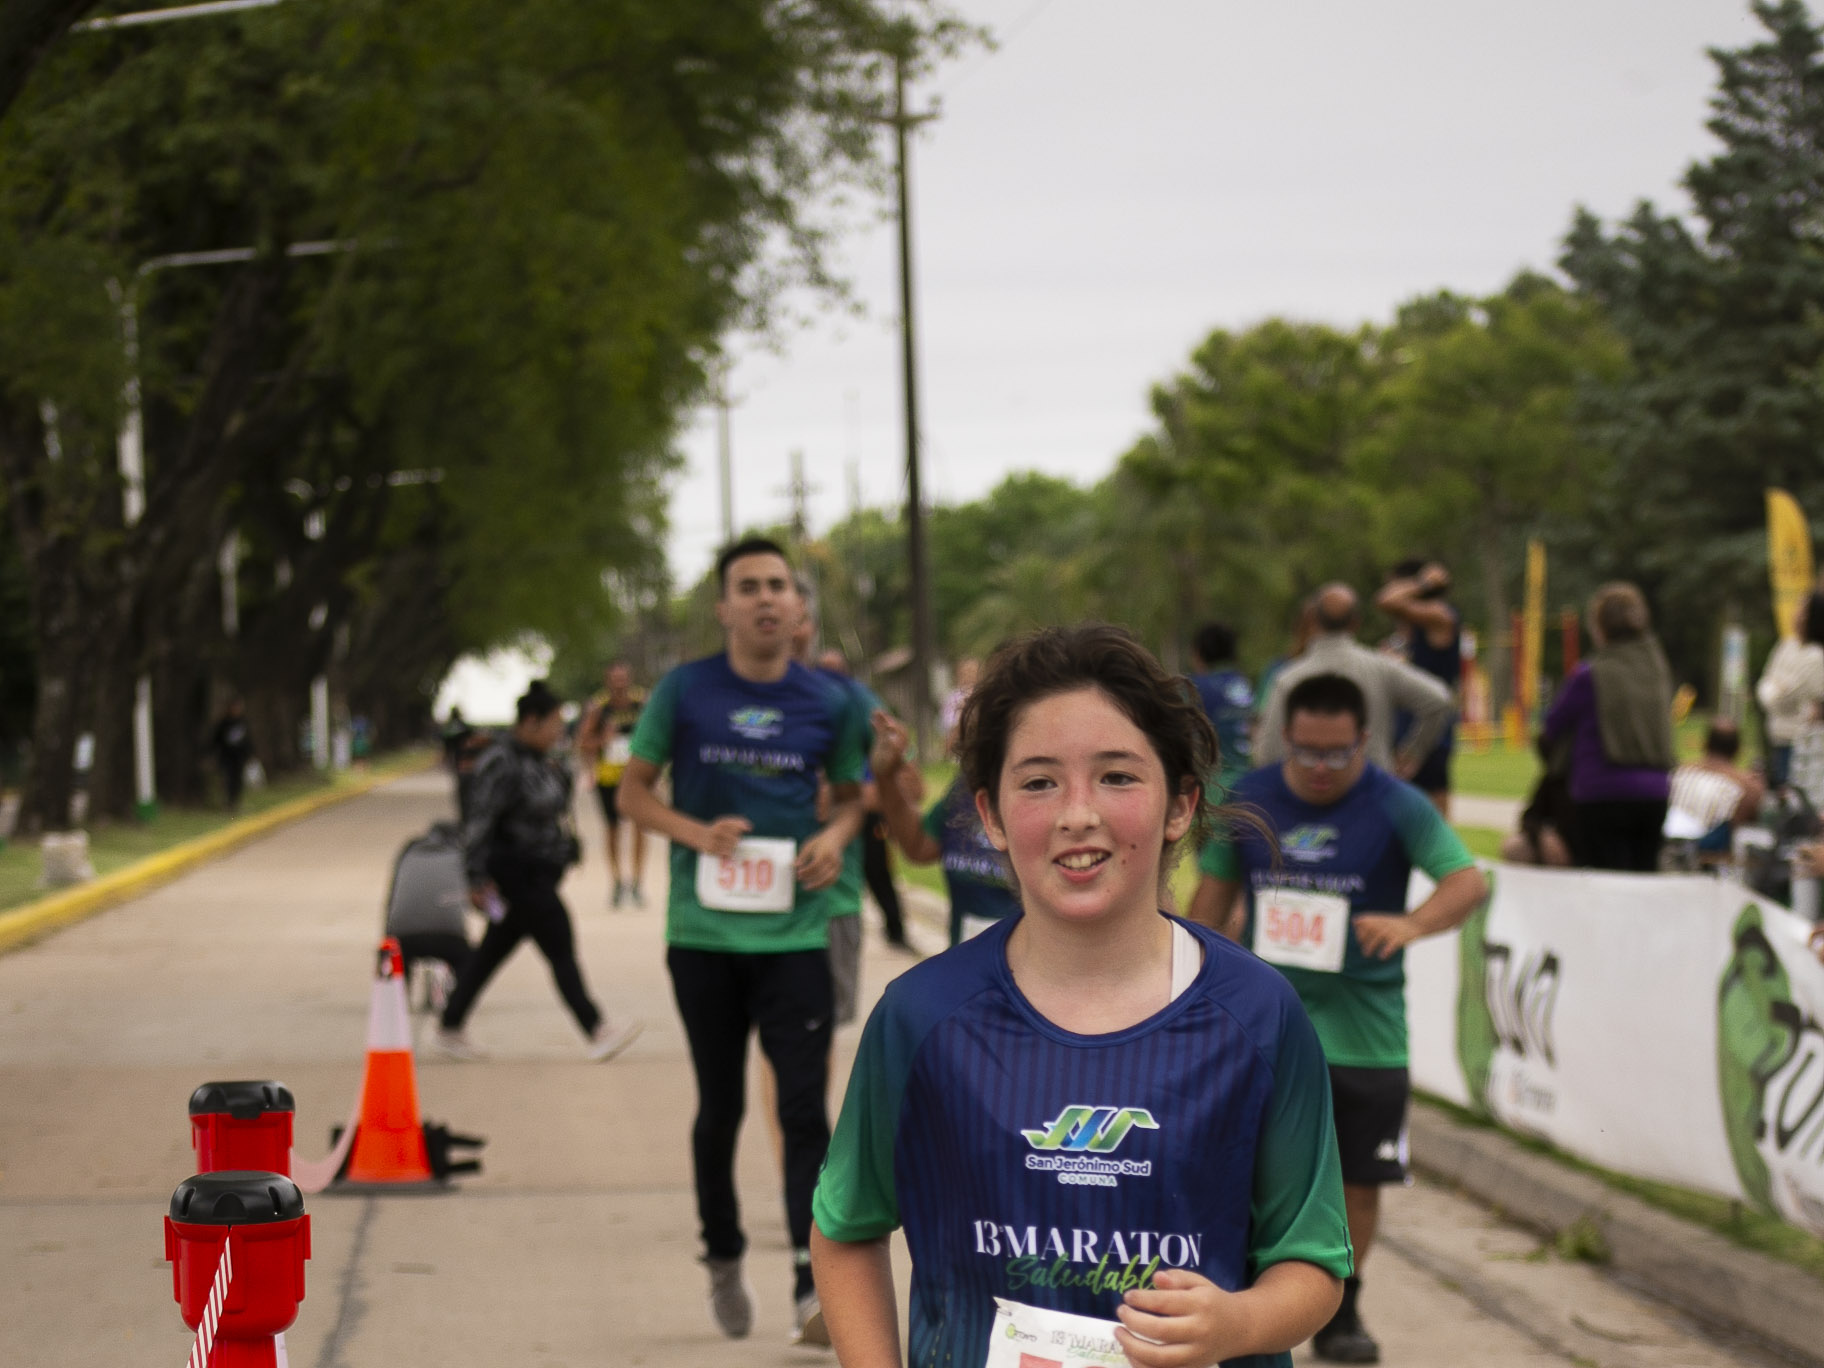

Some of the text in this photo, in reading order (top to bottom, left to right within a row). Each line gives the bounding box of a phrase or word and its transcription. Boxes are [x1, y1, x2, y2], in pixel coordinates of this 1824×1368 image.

[1027, 1156, 1151, 1176] San Jerónimo Sud
[1058, 1173, 1117, 1187] COMUNA
[1006, 1251, 1163, 1295] Saludabl
